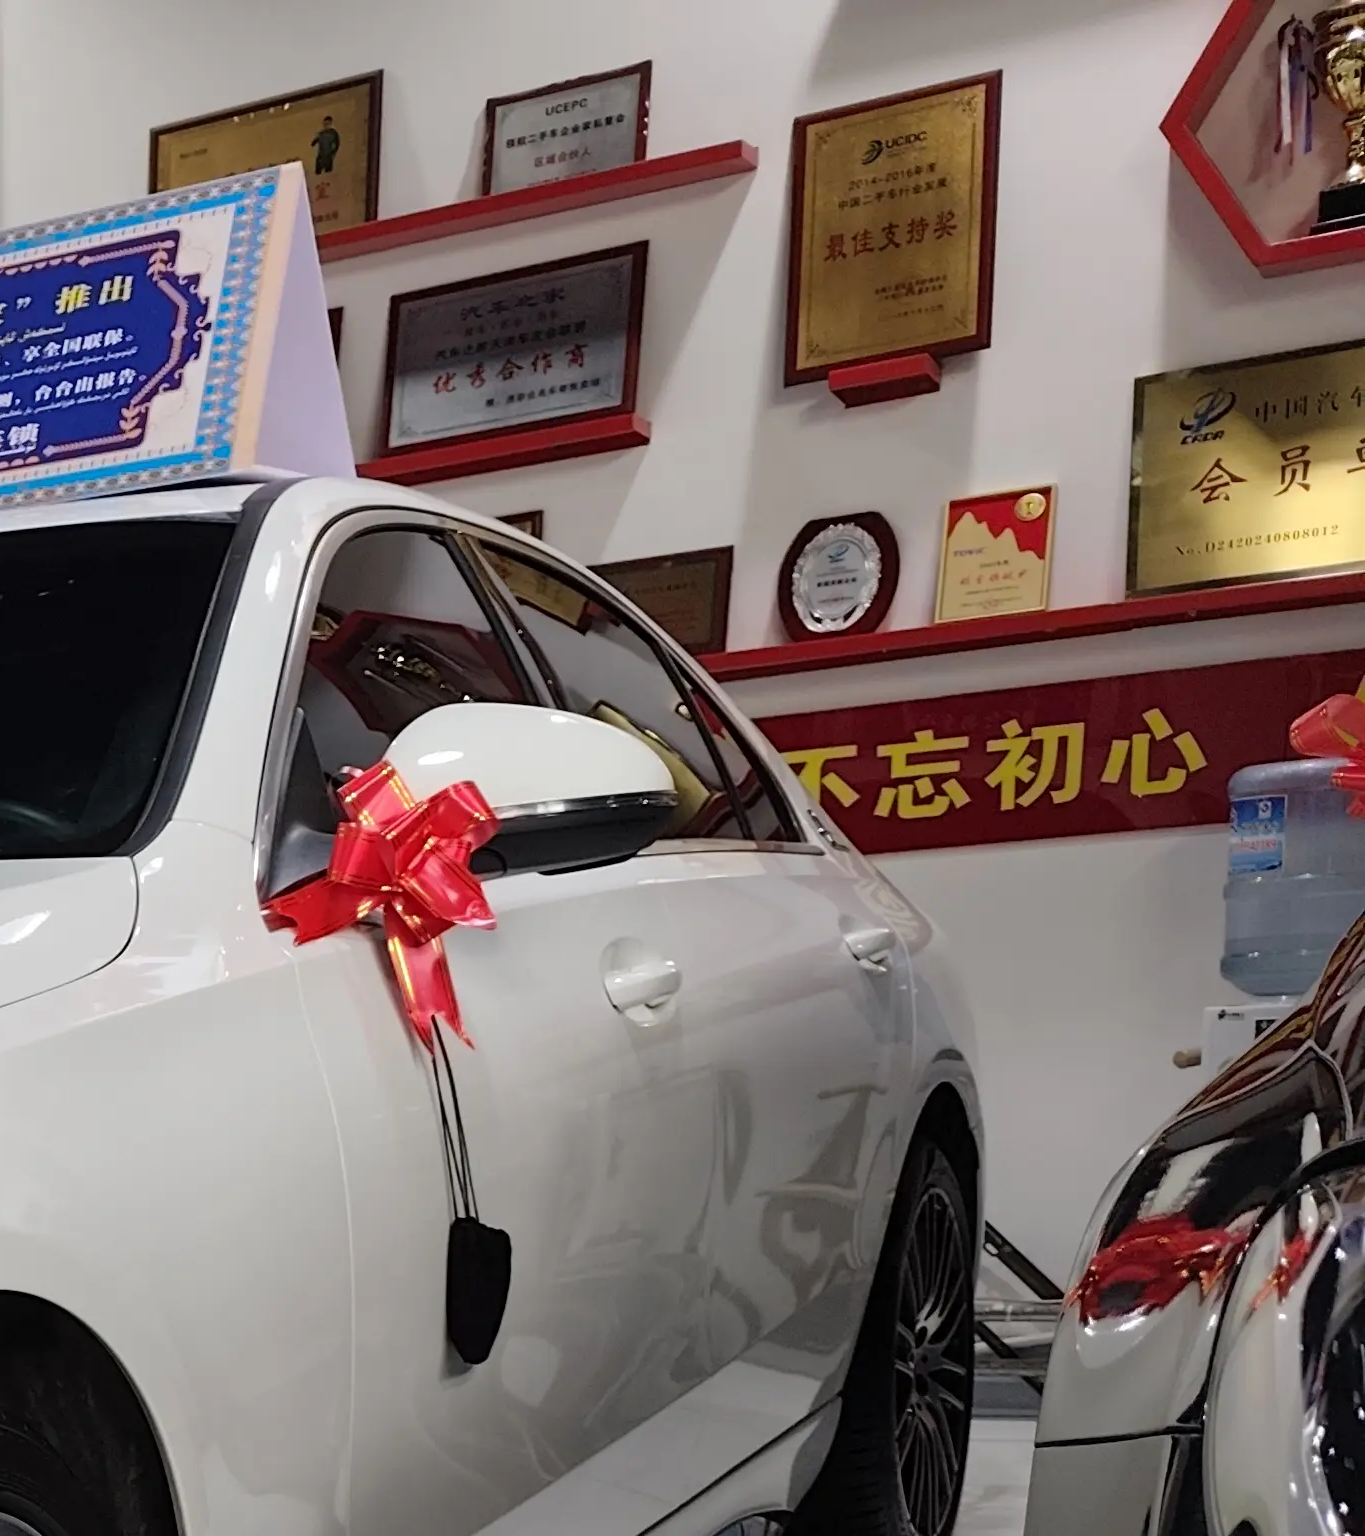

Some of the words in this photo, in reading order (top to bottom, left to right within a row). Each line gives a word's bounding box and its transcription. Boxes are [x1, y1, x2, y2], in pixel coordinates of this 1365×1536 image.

[545, 98, 588, 117] UCEPC
[885, 130, 928, 149] UCIDC
[823, 208, 958, 262] 最佳支持奖
[54, 274, 135, 315] 推出
[432, 342, 589, 395] 优秀合作商
[787, 707, 1208, 820] 不忘初心
